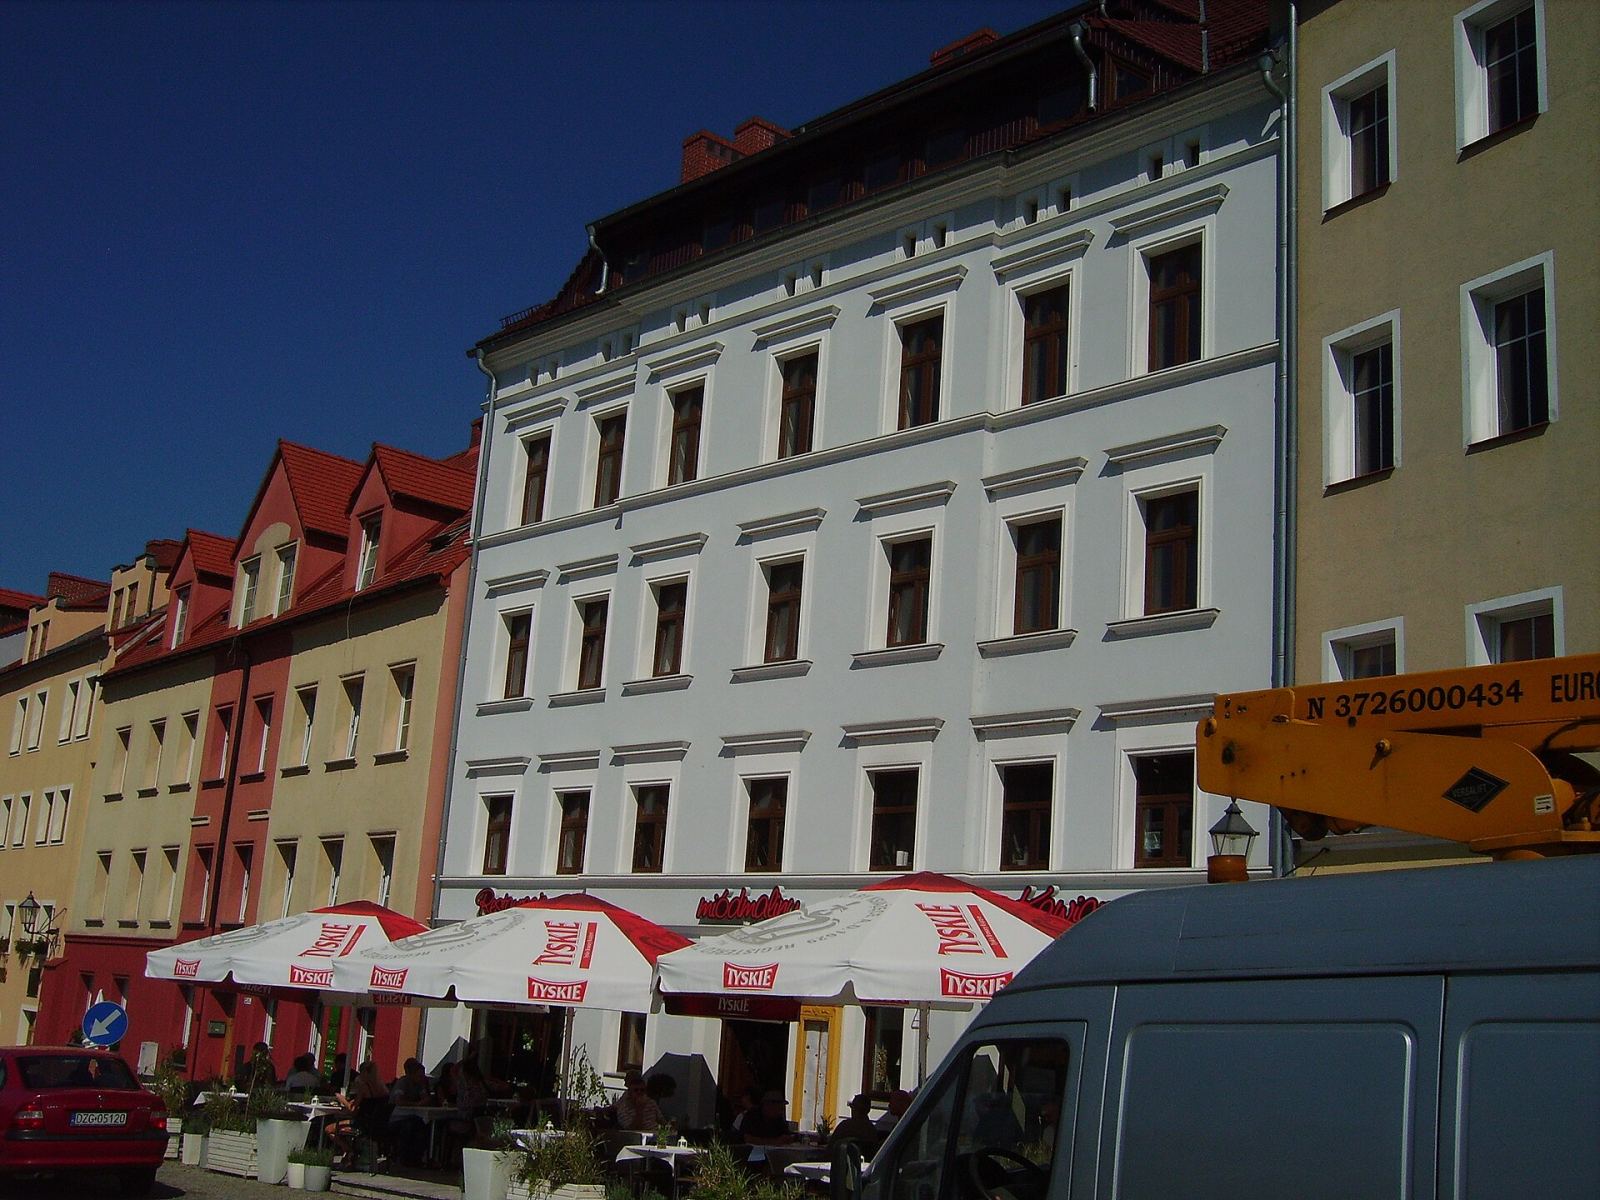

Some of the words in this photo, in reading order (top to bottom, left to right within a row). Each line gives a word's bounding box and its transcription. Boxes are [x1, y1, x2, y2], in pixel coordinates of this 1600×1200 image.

[1551, 671, 1600, 702] EUR
[1307, 697, 1326, 720] N
[1335, 679, 1524, 718] 3726000434
[298, 922, 352, 957] TYSKIE
[915, 903, 986, 956] TYSKIE
[532, 921, 582, 966] TYSKIE
[176, 961, 197, 976] TYSKIE
[372, 970, 404, 987] TYSKIE
[727, 967, 773, 986] TYSKIE
[531, 982, 583, 1000] TYSKIE
[718, 997, 750, 1012] TYSKIE
